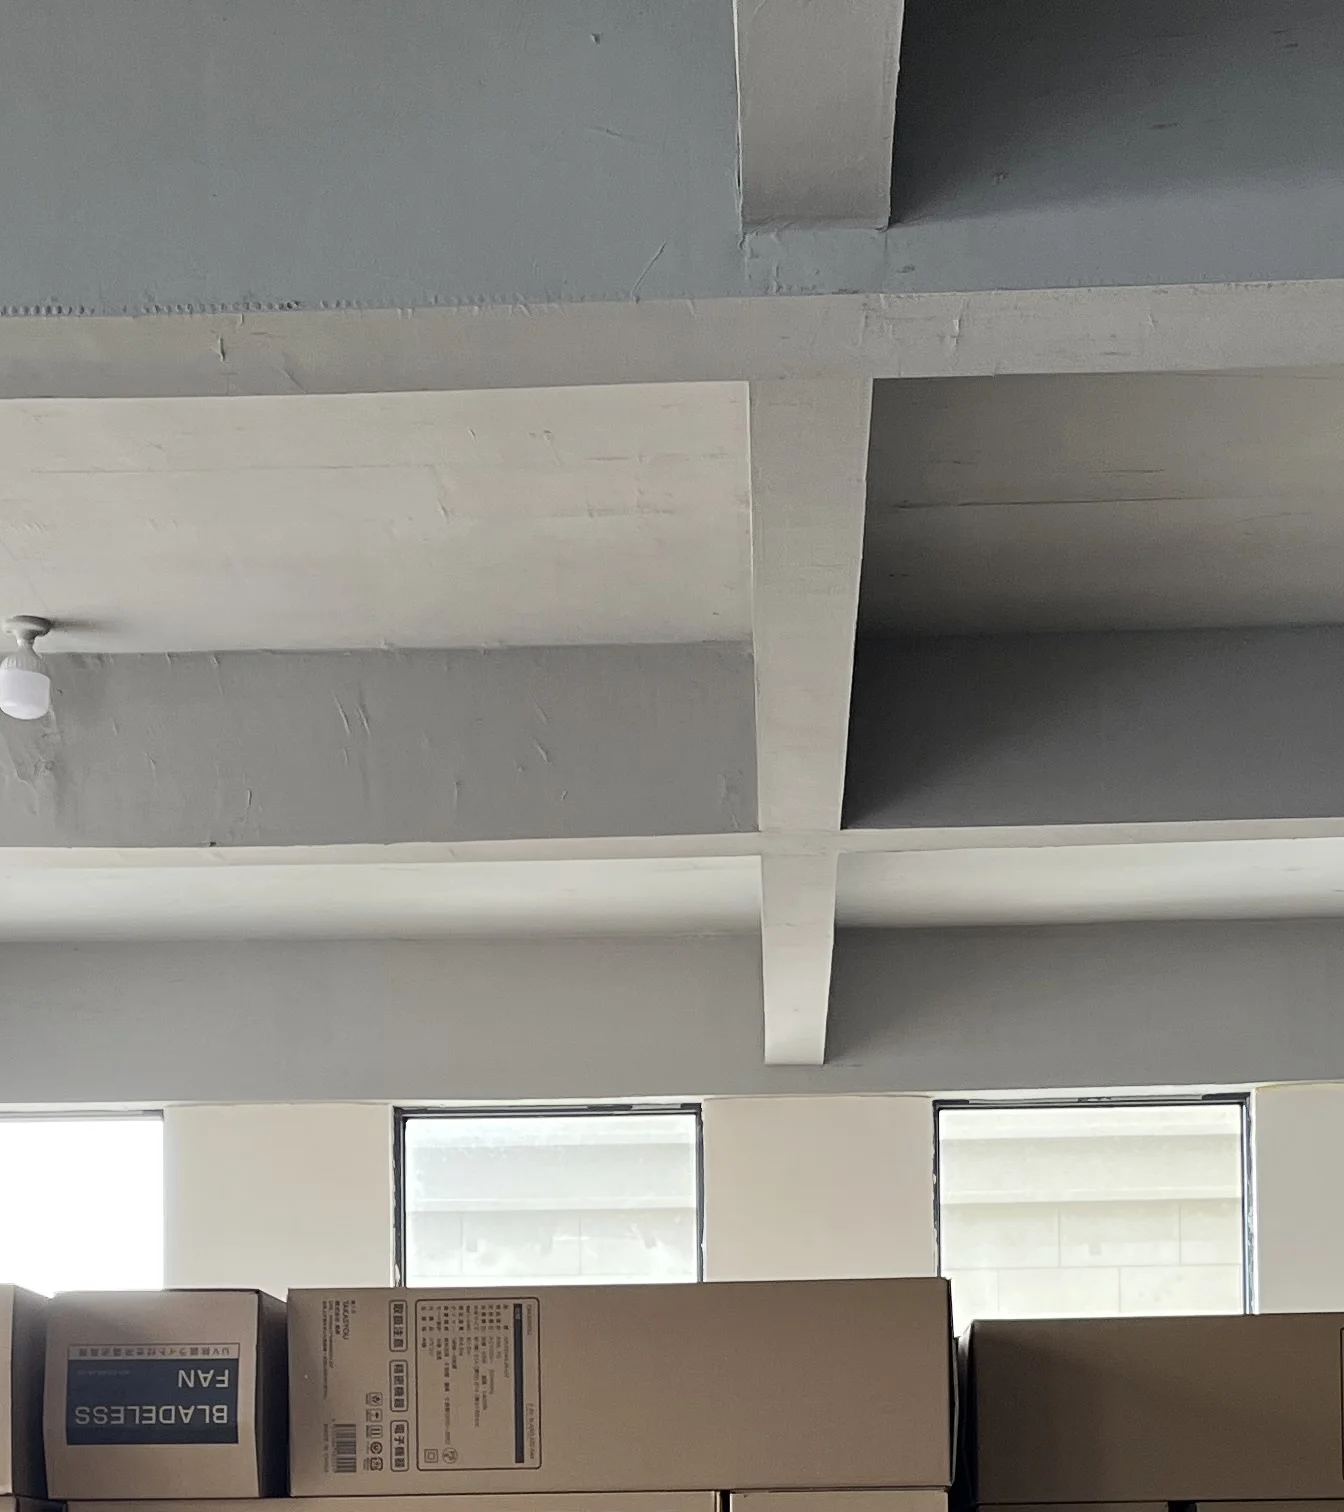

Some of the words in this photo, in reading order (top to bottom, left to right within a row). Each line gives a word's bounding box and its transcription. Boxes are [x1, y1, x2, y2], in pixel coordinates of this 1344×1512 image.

[393, 1304, 404, 1347] 取扱注意
[179, 1370, 228, 1387] FAN
[77, 1405, 227, 1423] BLADELESS
[395, 1424, 405, 1467] 電子機器
